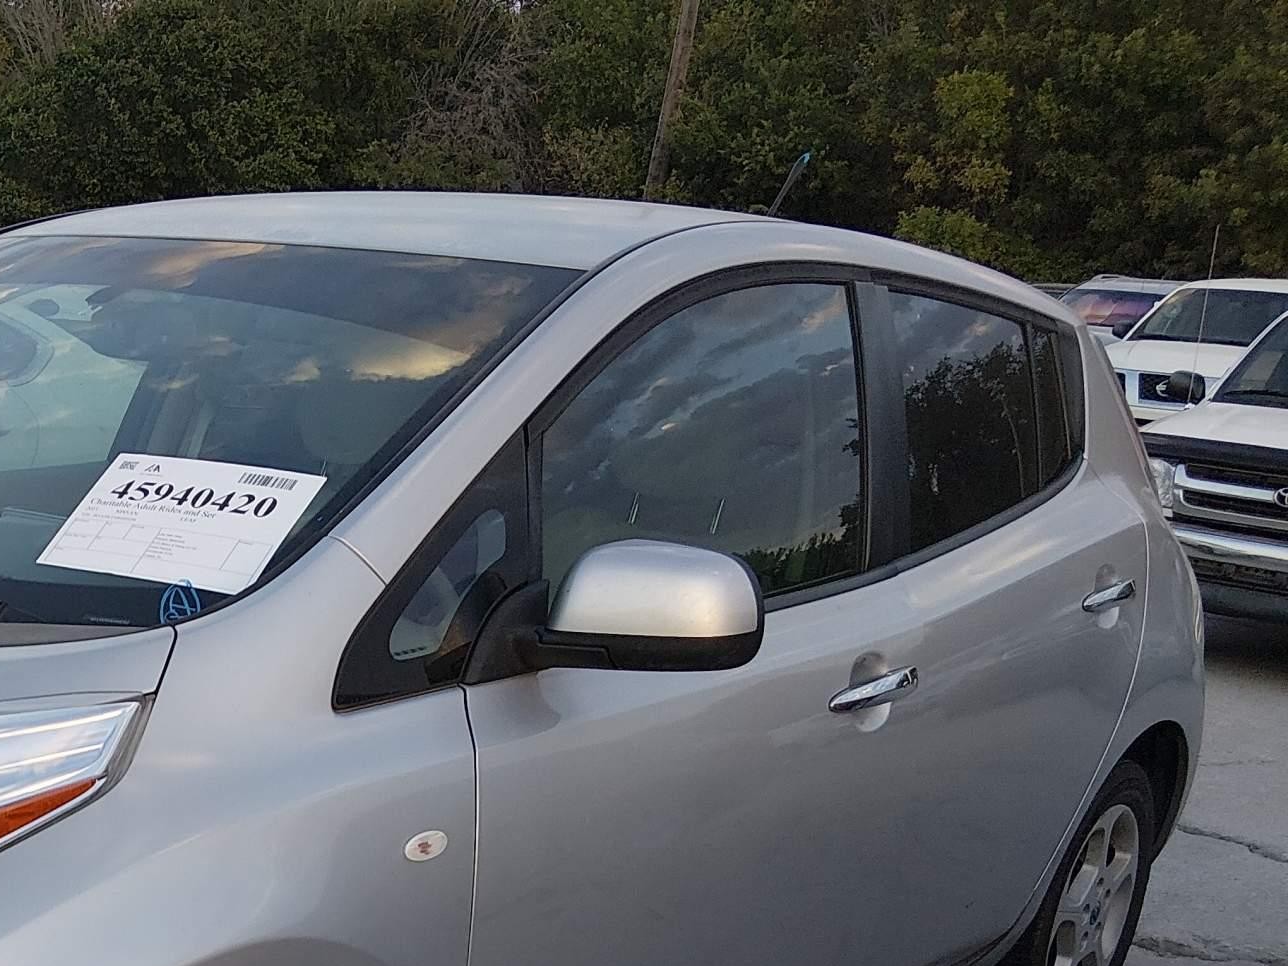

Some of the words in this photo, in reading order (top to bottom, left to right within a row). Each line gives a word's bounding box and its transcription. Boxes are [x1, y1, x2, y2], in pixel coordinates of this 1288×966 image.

[90, 498, 132, 509] Charitable
[135, 502, 158, 511] Adult
[158, 505, 182, 514] Rides
[183, 508, 200, 518] and
[110, 480, 278, 518] 45940420
